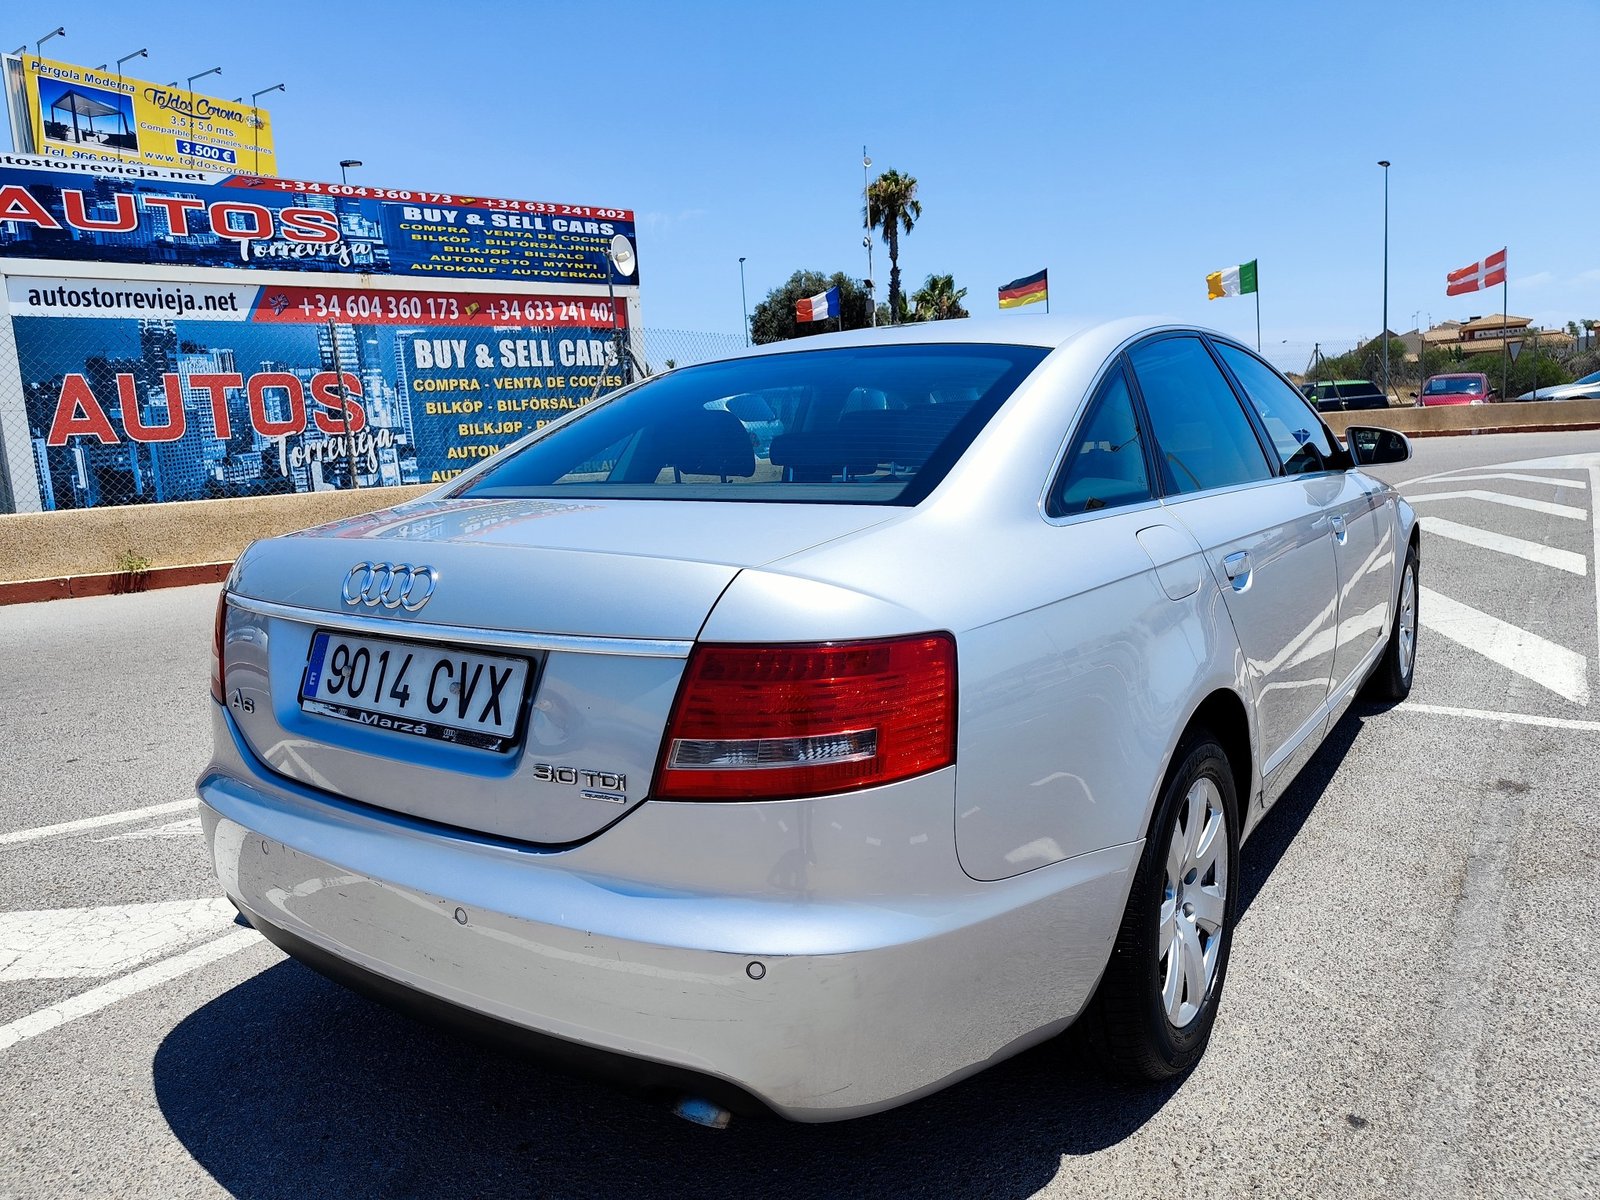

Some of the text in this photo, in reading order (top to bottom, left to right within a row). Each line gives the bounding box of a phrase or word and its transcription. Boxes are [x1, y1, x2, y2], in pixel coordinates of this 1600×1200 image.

[31, 61, 135, 92] Pérgola Moderna
[144, 88, 243, 123] Toldos Corona
[140, 122, 273, 155] Compatible con paneles solares
[171, 115, 186, 127] 3.5
[198, 121, 213, 132] 5.0
[215, 127, 237, 138] mts.
[43, 144, 68, 158] Tel.
[182, 142, 233, 162] 3.500 €
[0, 155, 206, 181] tostorrevieja.net
[274, 181, 626, 219] +34 604 360 173 +34 633 241 402
[0, 184, 341, 244] AUTOS
[402, 206, 615, 236] BUY & SELL CARS
[399, 223, 469, 234] COMPRA
[483, 229, 534, 239] VENTA
[411, 233, 471, 244] BILKÖP
[231, 238, 369, 267] Torrevieja
[430, 254, 485, 264] AUTON
[490, 257, 530, 266] OSTO
[543, 261, 598, 270] MYYNTI
[443, 245, 510, 256] BILKJØP
[524, 251, 585, 260] BILSALG
[411, 263, 497, 274] AUTOKAUF
[28, 286, 238, 315] autostorrevieja.net
[299, 294, 341, 316] +34
[345, 295, 383, 318] 604
[387, 296, 422, 319] 360
[426, 297, 459, 319] 173
[486, 299, 521, 320] +34
[525, 301, 555, 321] 633
[558, 301, 586, 321] 241
[414, 339, 619, 369] BUY & SELL CARS
[413, 378, 480, 392] COMPRA
[493, 377, 543, 390] VENTA
[547, 376, 565, 388] DE
[47, 371, 366, 447] AUTOS
[425, 399, 483, 415] BILKÖP
[458, 421, 523, 436] BILKJØP
[271, 425, 394, 477] Torrevieja
[447, 445, 500, 459] AUTON
[309, 673, 317, 685] E
[326, 644, 513, 726] 9014 CVX
[232, 688, 254, 713] A6
[359, 712, 427, 735] Marzá
